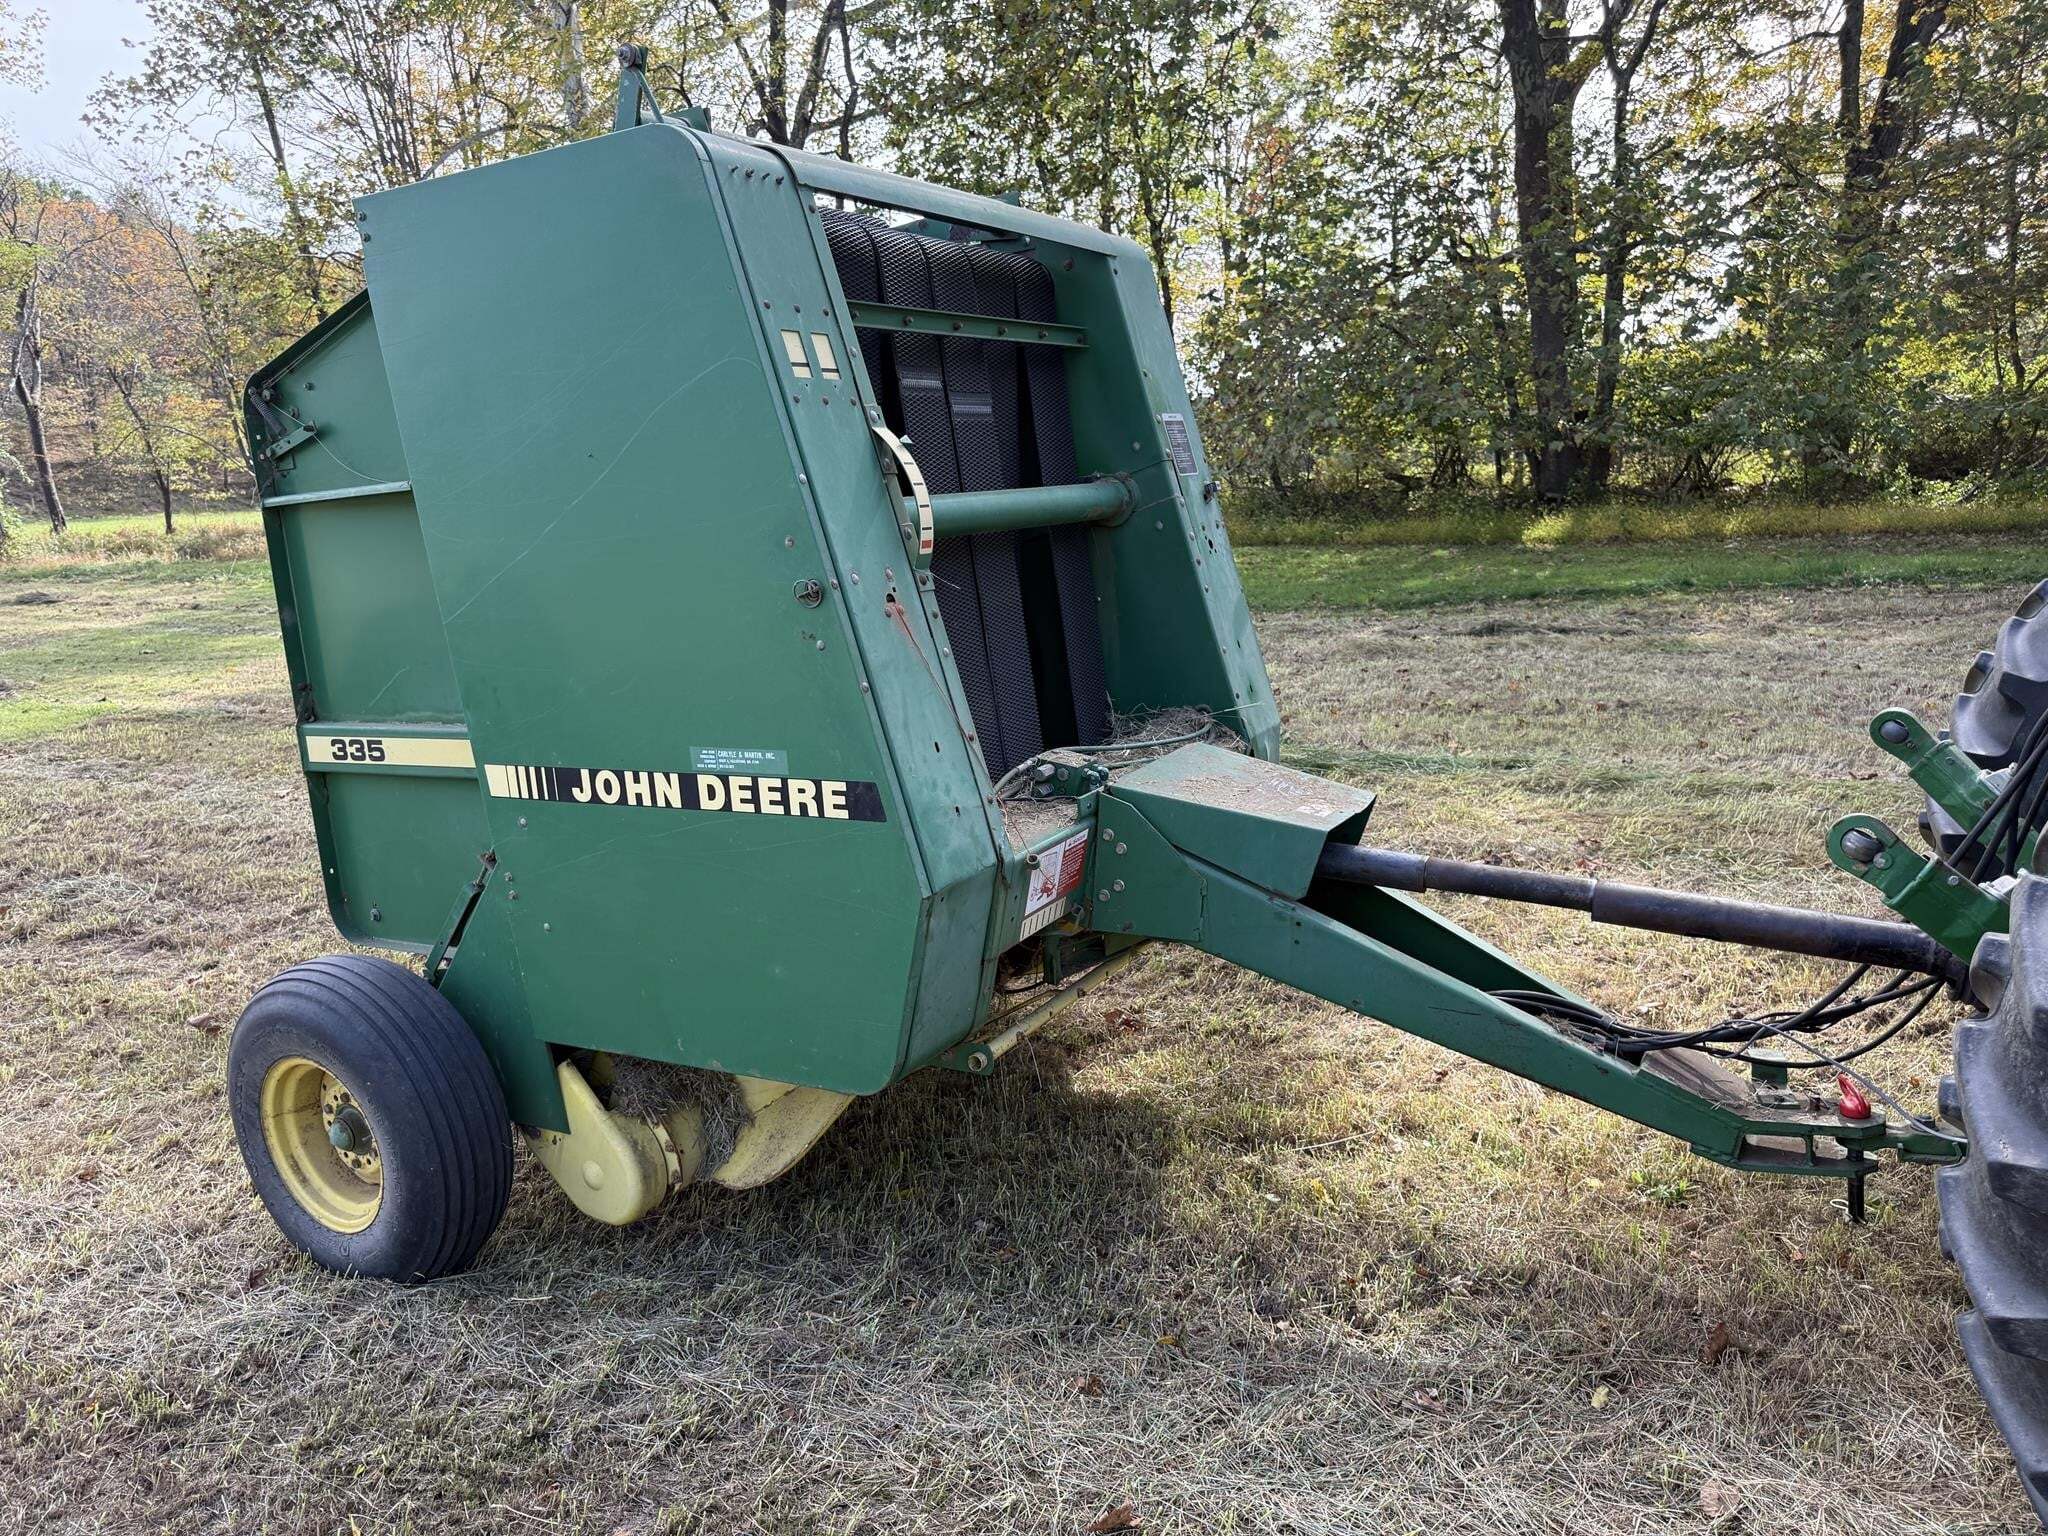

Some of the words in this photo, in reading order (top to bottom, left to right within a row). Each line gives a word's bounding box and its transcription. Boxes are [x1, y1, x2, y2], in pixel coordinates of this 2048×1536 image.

[331, 738, 386, 762] 335
[571, 768, 682, 809] JOHN
[697, 774, 850, 819] DEERE
